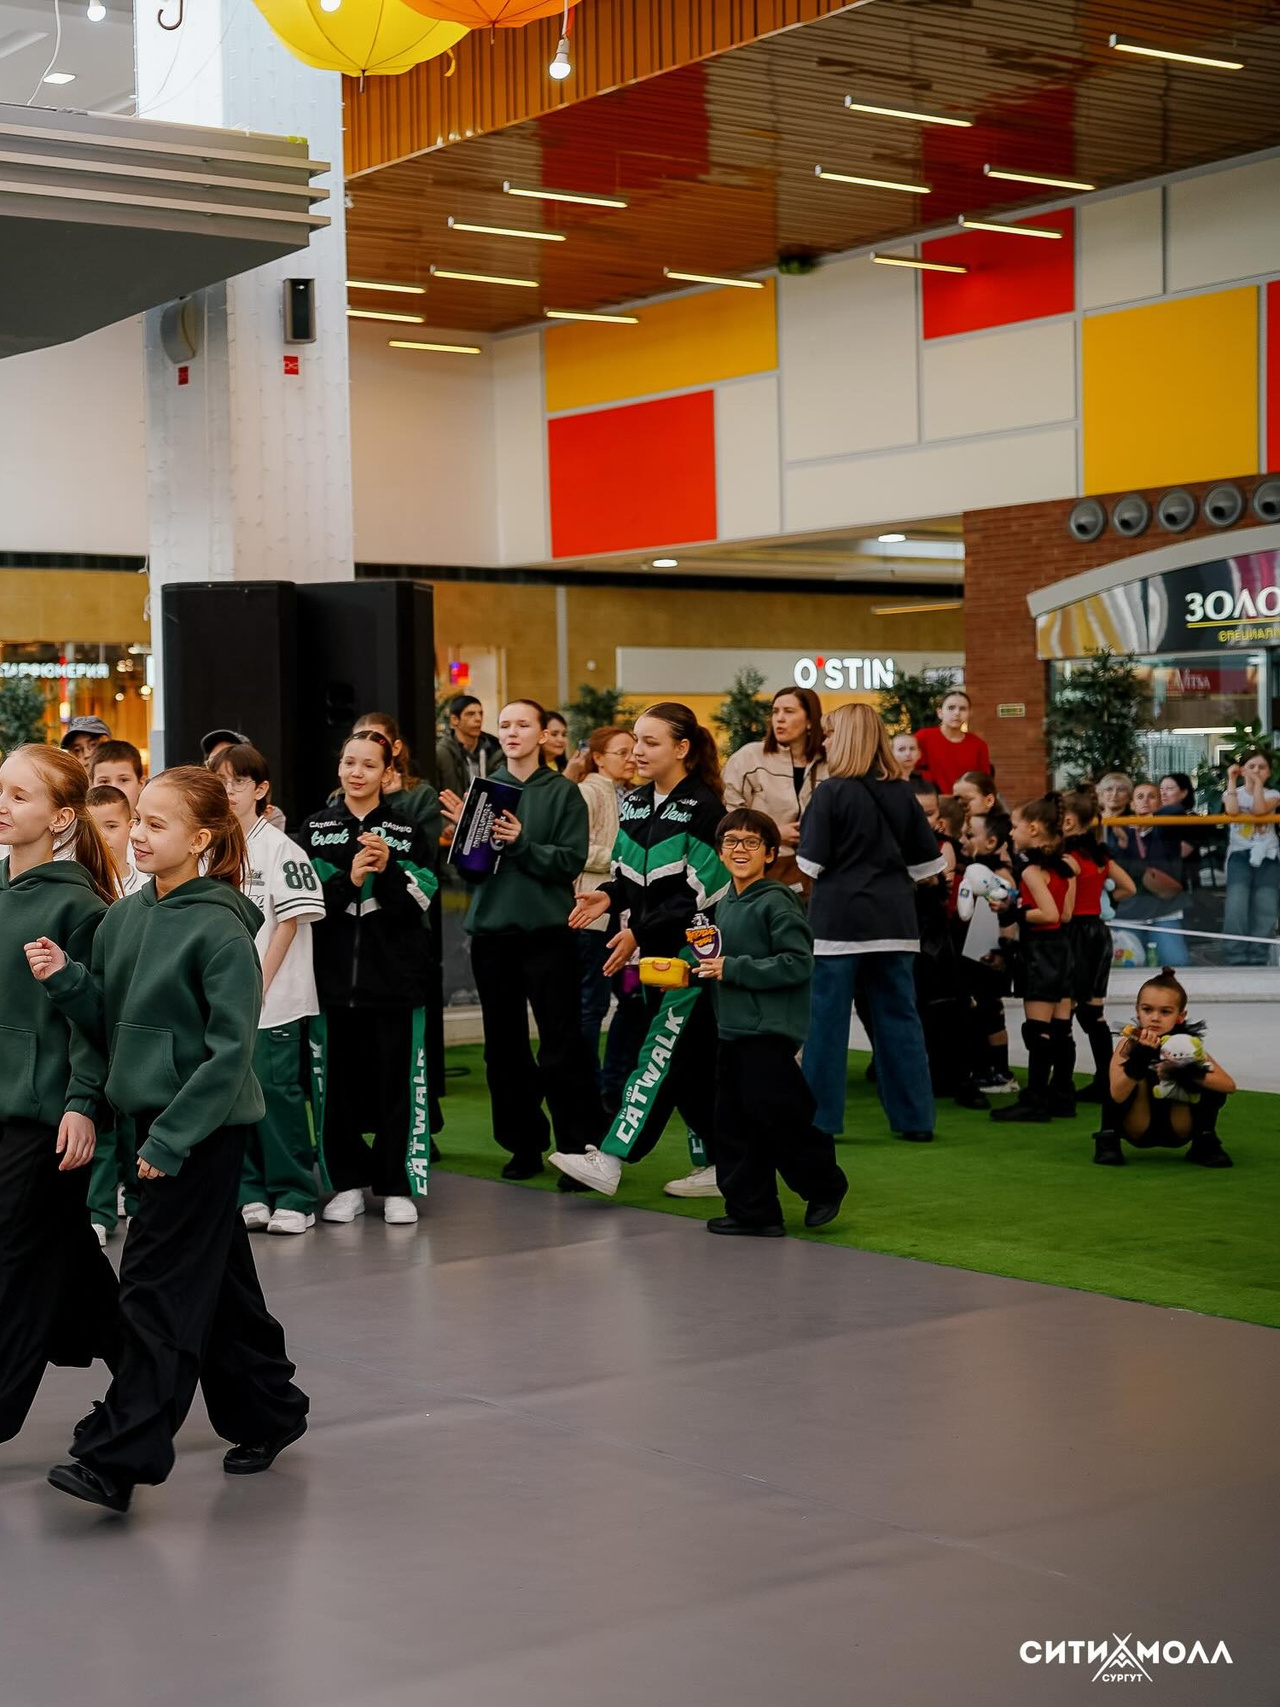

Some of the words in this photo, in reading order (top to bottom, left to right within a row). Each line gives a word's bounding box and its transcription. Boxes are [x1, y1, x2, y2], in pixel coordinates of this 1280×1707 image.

[1185, 586, 1280, 622] ЗОЛО
[794, 655, 895, 690] O'STIN
[282, 860, 318, 892] 88
[616, 1007, 684, 1144] CATWALK
